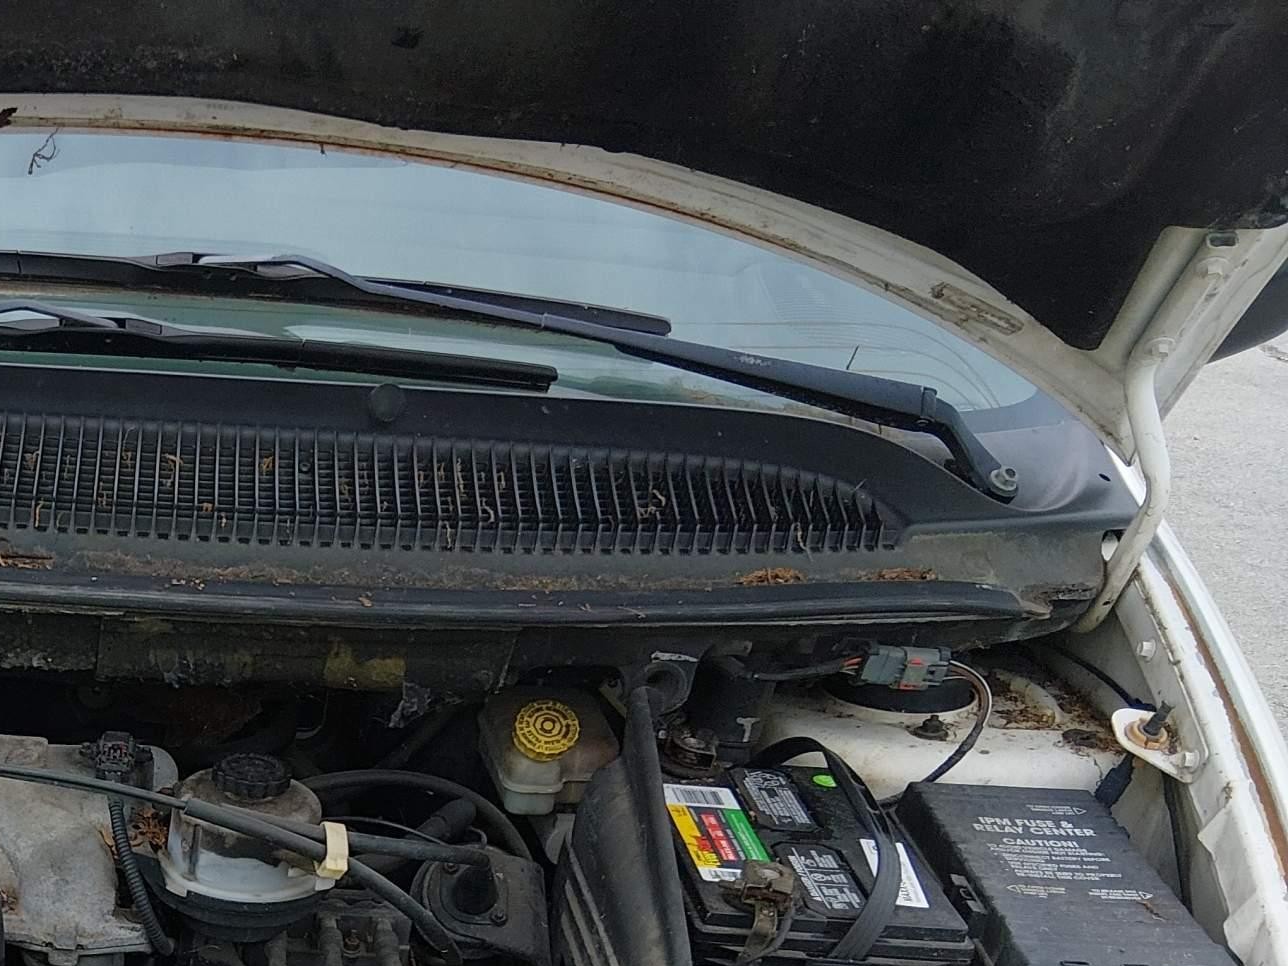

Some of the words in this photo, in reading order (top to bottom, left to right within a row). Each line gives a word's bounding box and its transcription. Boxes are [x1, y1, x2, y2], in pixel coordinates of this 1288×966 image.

[1014, 818, 1056, 828] FUSE
[1060, 820, 1074, 829] &
[972, 823, 1024, 835] RELAY
[1029, 826, 1097, 837] CENTER
[1002, 838, 1080, 848] CAUTION!
